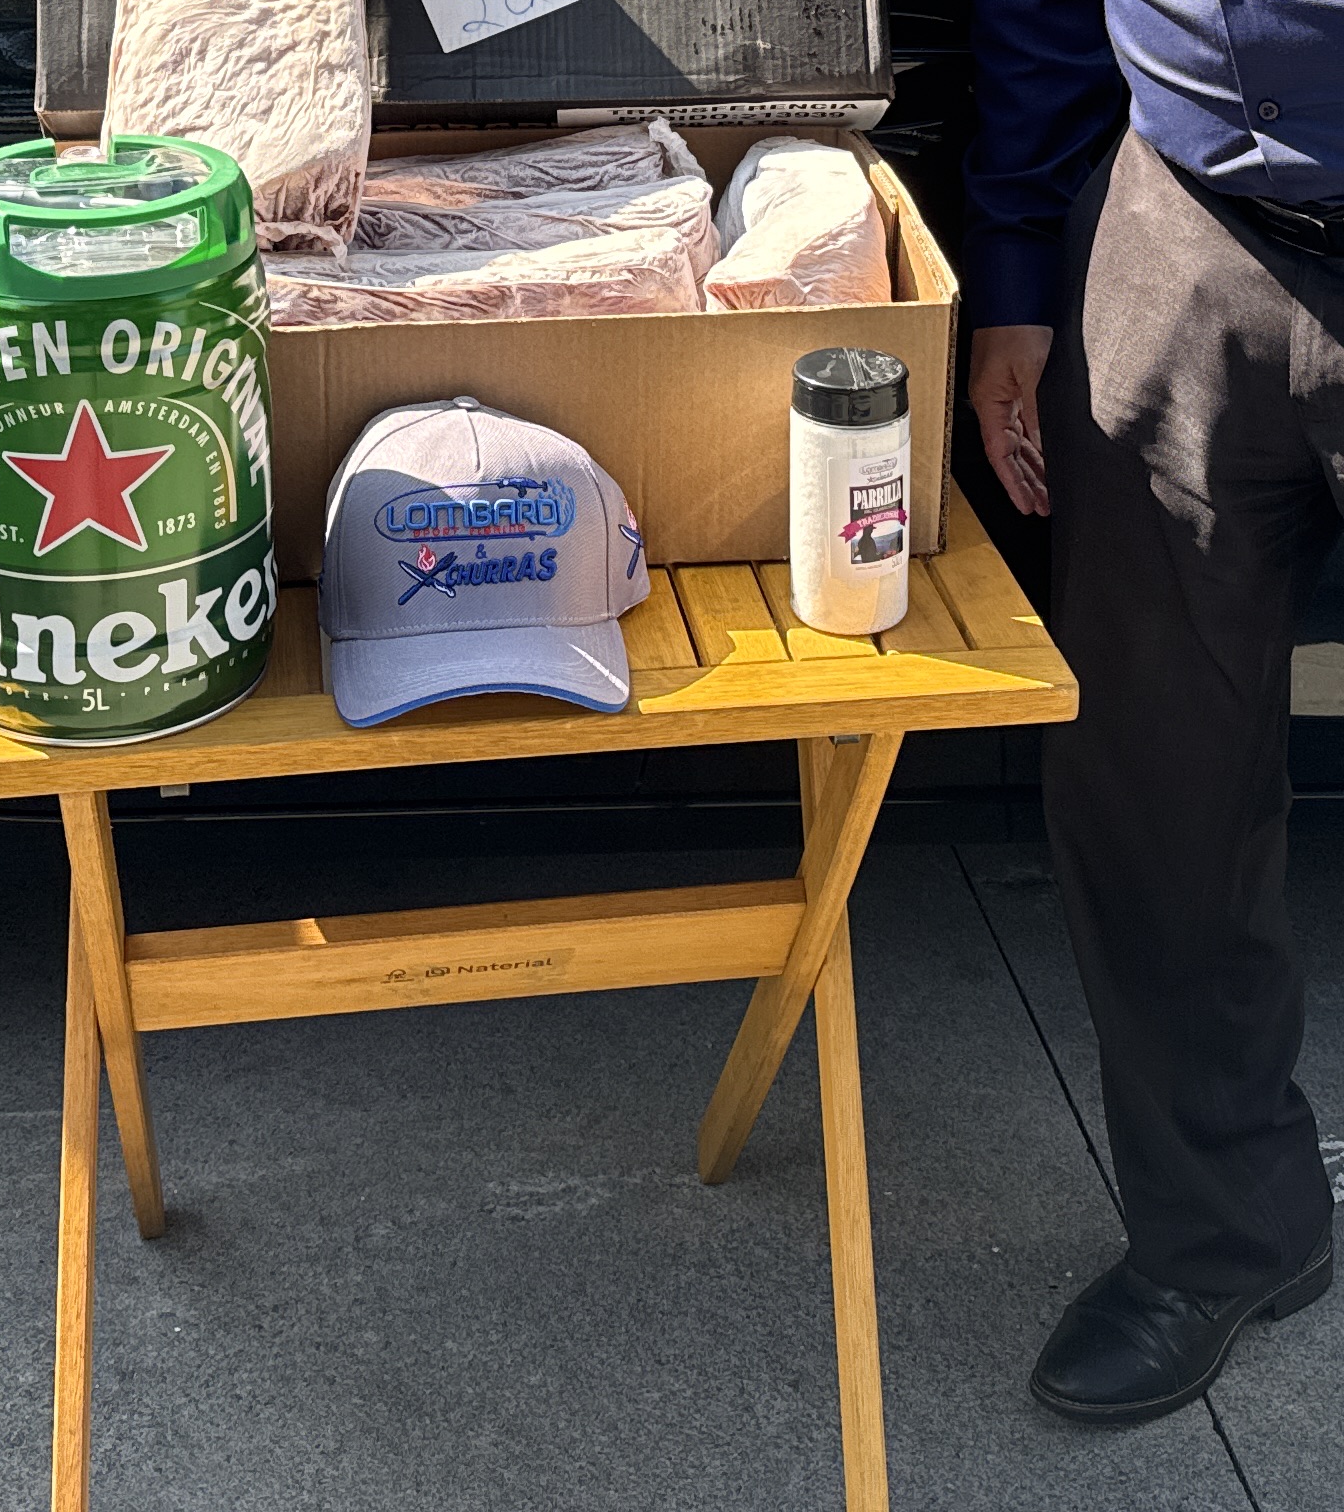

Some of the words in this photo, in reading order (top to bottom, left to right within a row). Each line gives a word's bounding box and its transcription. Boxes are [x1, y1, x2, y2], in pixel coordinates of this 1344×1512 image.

[607, 104, 859, 115] TRANSFERENCIA
[101, 319, 270, 487] ORIGINAL
[104, 399, 210, 448] AMSTERDAM
[205, 450, 222, 476] EN
[212, 483, 227, 530] 1883
[853, 480, 902, 510] PARRILLA
[157, 512, 196, 536] 1873
[386, 497, 561, 532] LOMBARDI
[82, 689, 110, 711] 5L
[457, 957, 553, 974] Naterial
